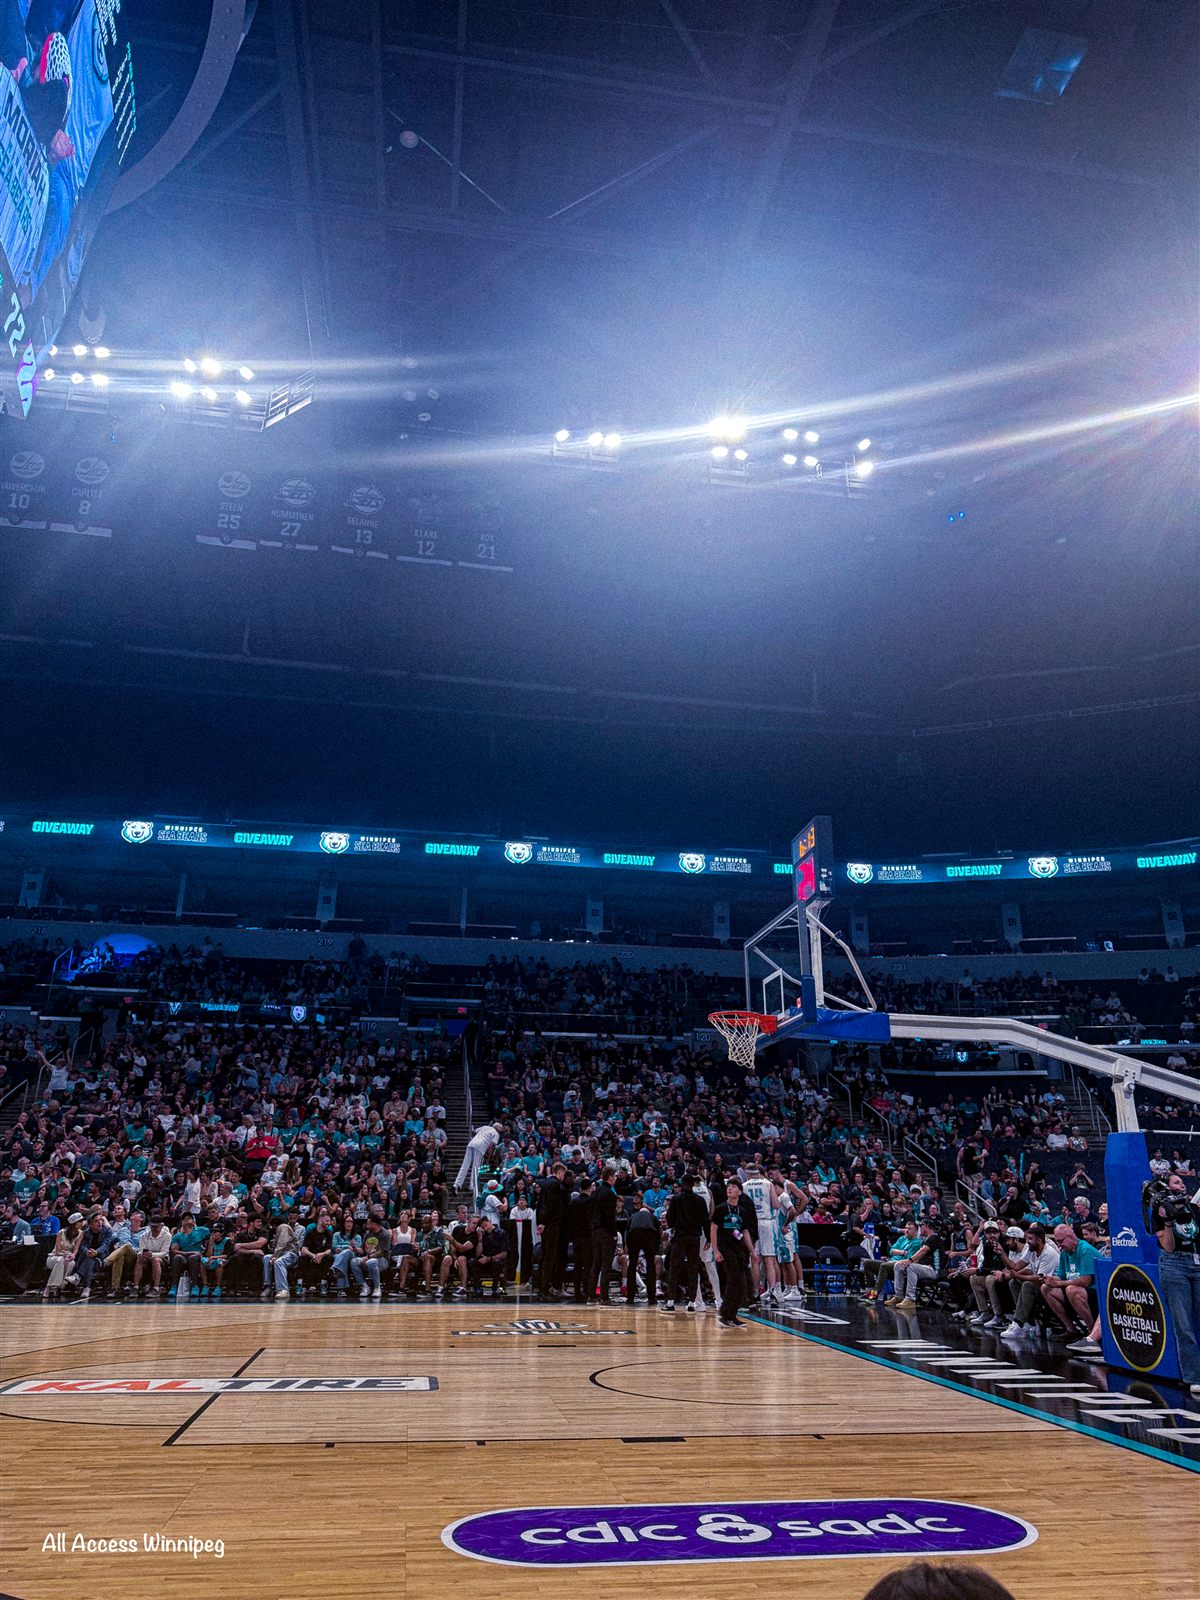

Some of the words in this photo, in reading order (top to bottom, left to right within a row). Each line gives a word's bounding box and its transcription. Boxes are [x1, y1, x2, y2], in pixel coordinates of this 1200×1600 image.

[3, 88, 46, 206] MORIAH
[8, 493, 30, 509] 10
[79, 500, 91, 515] 8
[219, 502, 243, 512] STEEN
[217, 513, 241, 530] 25
[281, 521, 301, 536] 27
[355, 529, 373, 544] 13
[417, 540, 436, 556] 12
[476, 543, 496, 560] 21
[32, 821, 94, 835] GIVEAWAY
[234, 832, 293, 847] GIVEAWAY
[425, 842, 480, 856] GIVEAWAY
[604, 853, 655, 867] GIVEAWAY
[1137, 852, 1197, 869] GIVEAWAY
[946, 865, 1002, 878] GIVEAWAY
[317, 938, 334, 946] 219
[696, 1033, 711, 1041] 120
[1112, 1237, 1138, 1247] Electrolit
[1112, 1288, 1154, 1305] CANADA'S
[1126, 1303, 1143, 1316] PRO
[1112, 1313, 1160, 1333] BASKETBALL
[1122, 1328, 1153, 1345] LEAGUE
[23, 1381, 205, 1393] KAL
[218, 1379, 415, 1390] TIRE
[520, 1521, 688, 1545] cdic
[777, 1513, 966, 1537] sadc
